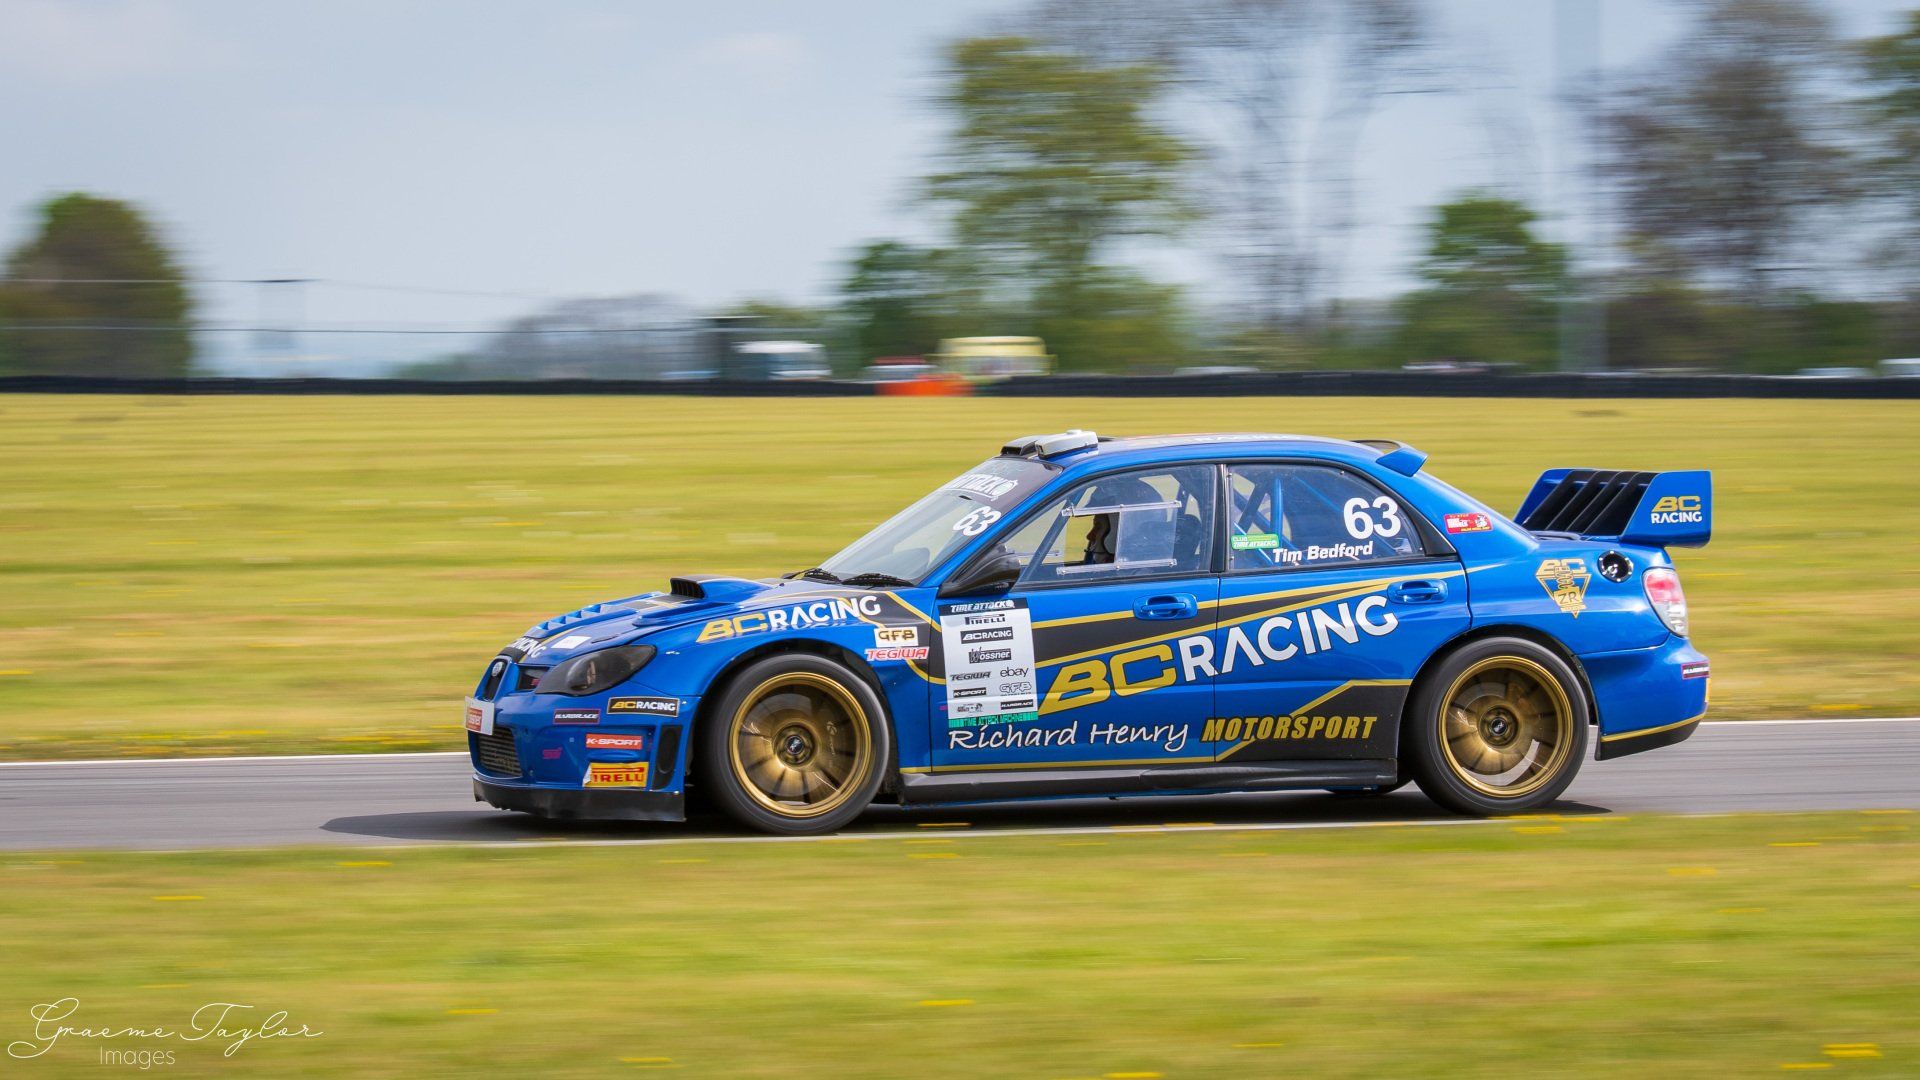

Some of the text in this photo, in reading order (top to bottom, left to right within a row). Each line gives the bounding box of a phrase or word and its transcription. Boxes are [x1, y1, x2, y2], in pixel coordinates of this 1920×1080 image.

[1652, 496, 1701, 512] BC
[953, 506, 1001, 536] 63
[1343, 496, 1401, 539] 63
[1651, 512, 1703, 524] RACING
[1272, 541, 1374, 563] Tim Bedford
[951, 600, 1006, 613] TIME ATTACK
[965, 613, 1006, 625] PIRELLI
[879, 629, 915, 641] GFB
[867, 648, 928, 660] TEGIWA
[950, 671, 992, 682] TEGIWA
[1000, 666, 1029, 678] ebay
[953, 688, 987, 697] K-SPORT
[1000, 681, 1032, 693] GFB
[1201, 716, 1378, 743] MOTORSPORT
[586, 738, 641, 746] K-SPORT
[949, 721, 1188, 752] Richard Henry
